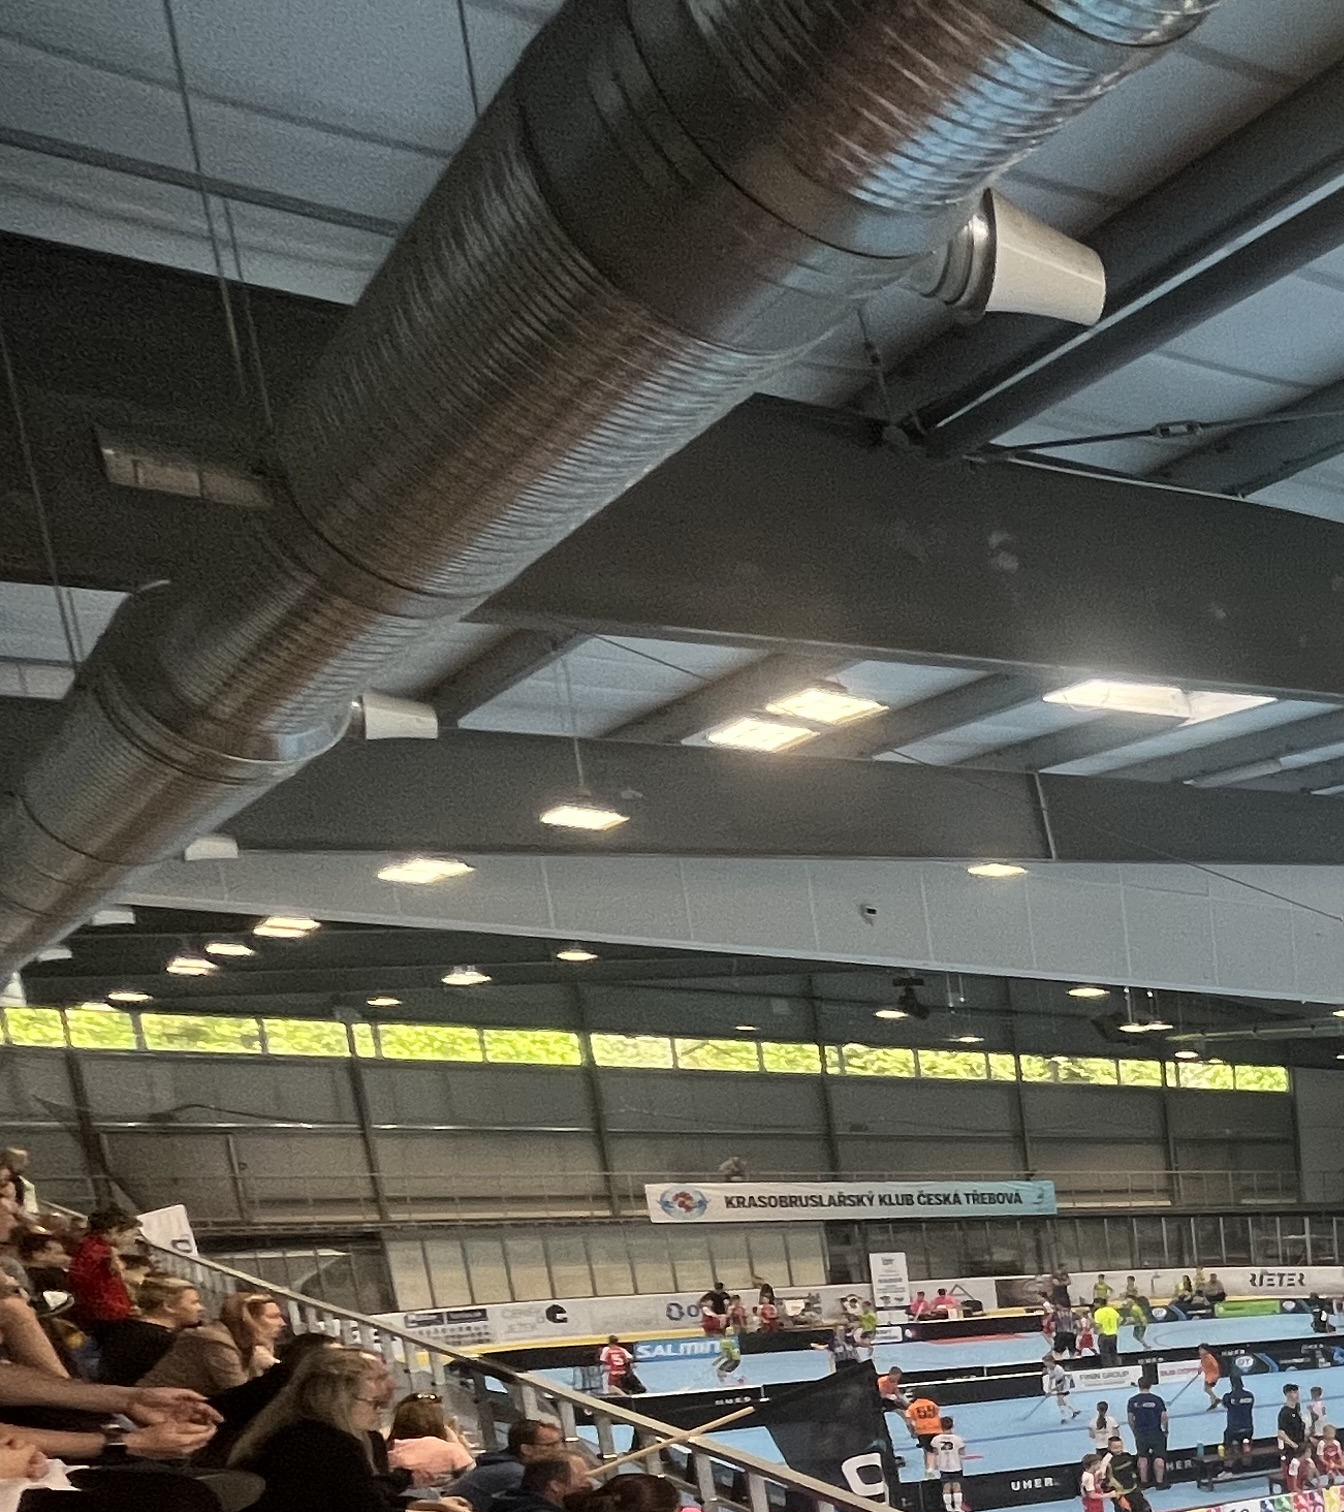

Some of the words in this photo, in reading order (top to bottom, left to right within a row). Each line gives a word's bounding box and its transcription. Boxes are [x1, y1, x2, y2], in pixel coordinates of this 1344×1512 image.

[724, 1192, 875, 1209] KRASOBRUSLAŘSKÝ
[878, 1193, 914, 1206] KLUB
[917, 1189, 962, 1206] ČESKÁ
[963, 1188, 1023, 1206] TŘEBOVÁ
[1249, 1271, 1306, 1288] RIETER
[636, 1340, 722, 1359] SALMIN
[1165, 1459, 1192, 1471] HER
[1011, 1477, 1054, 1491] UHER
